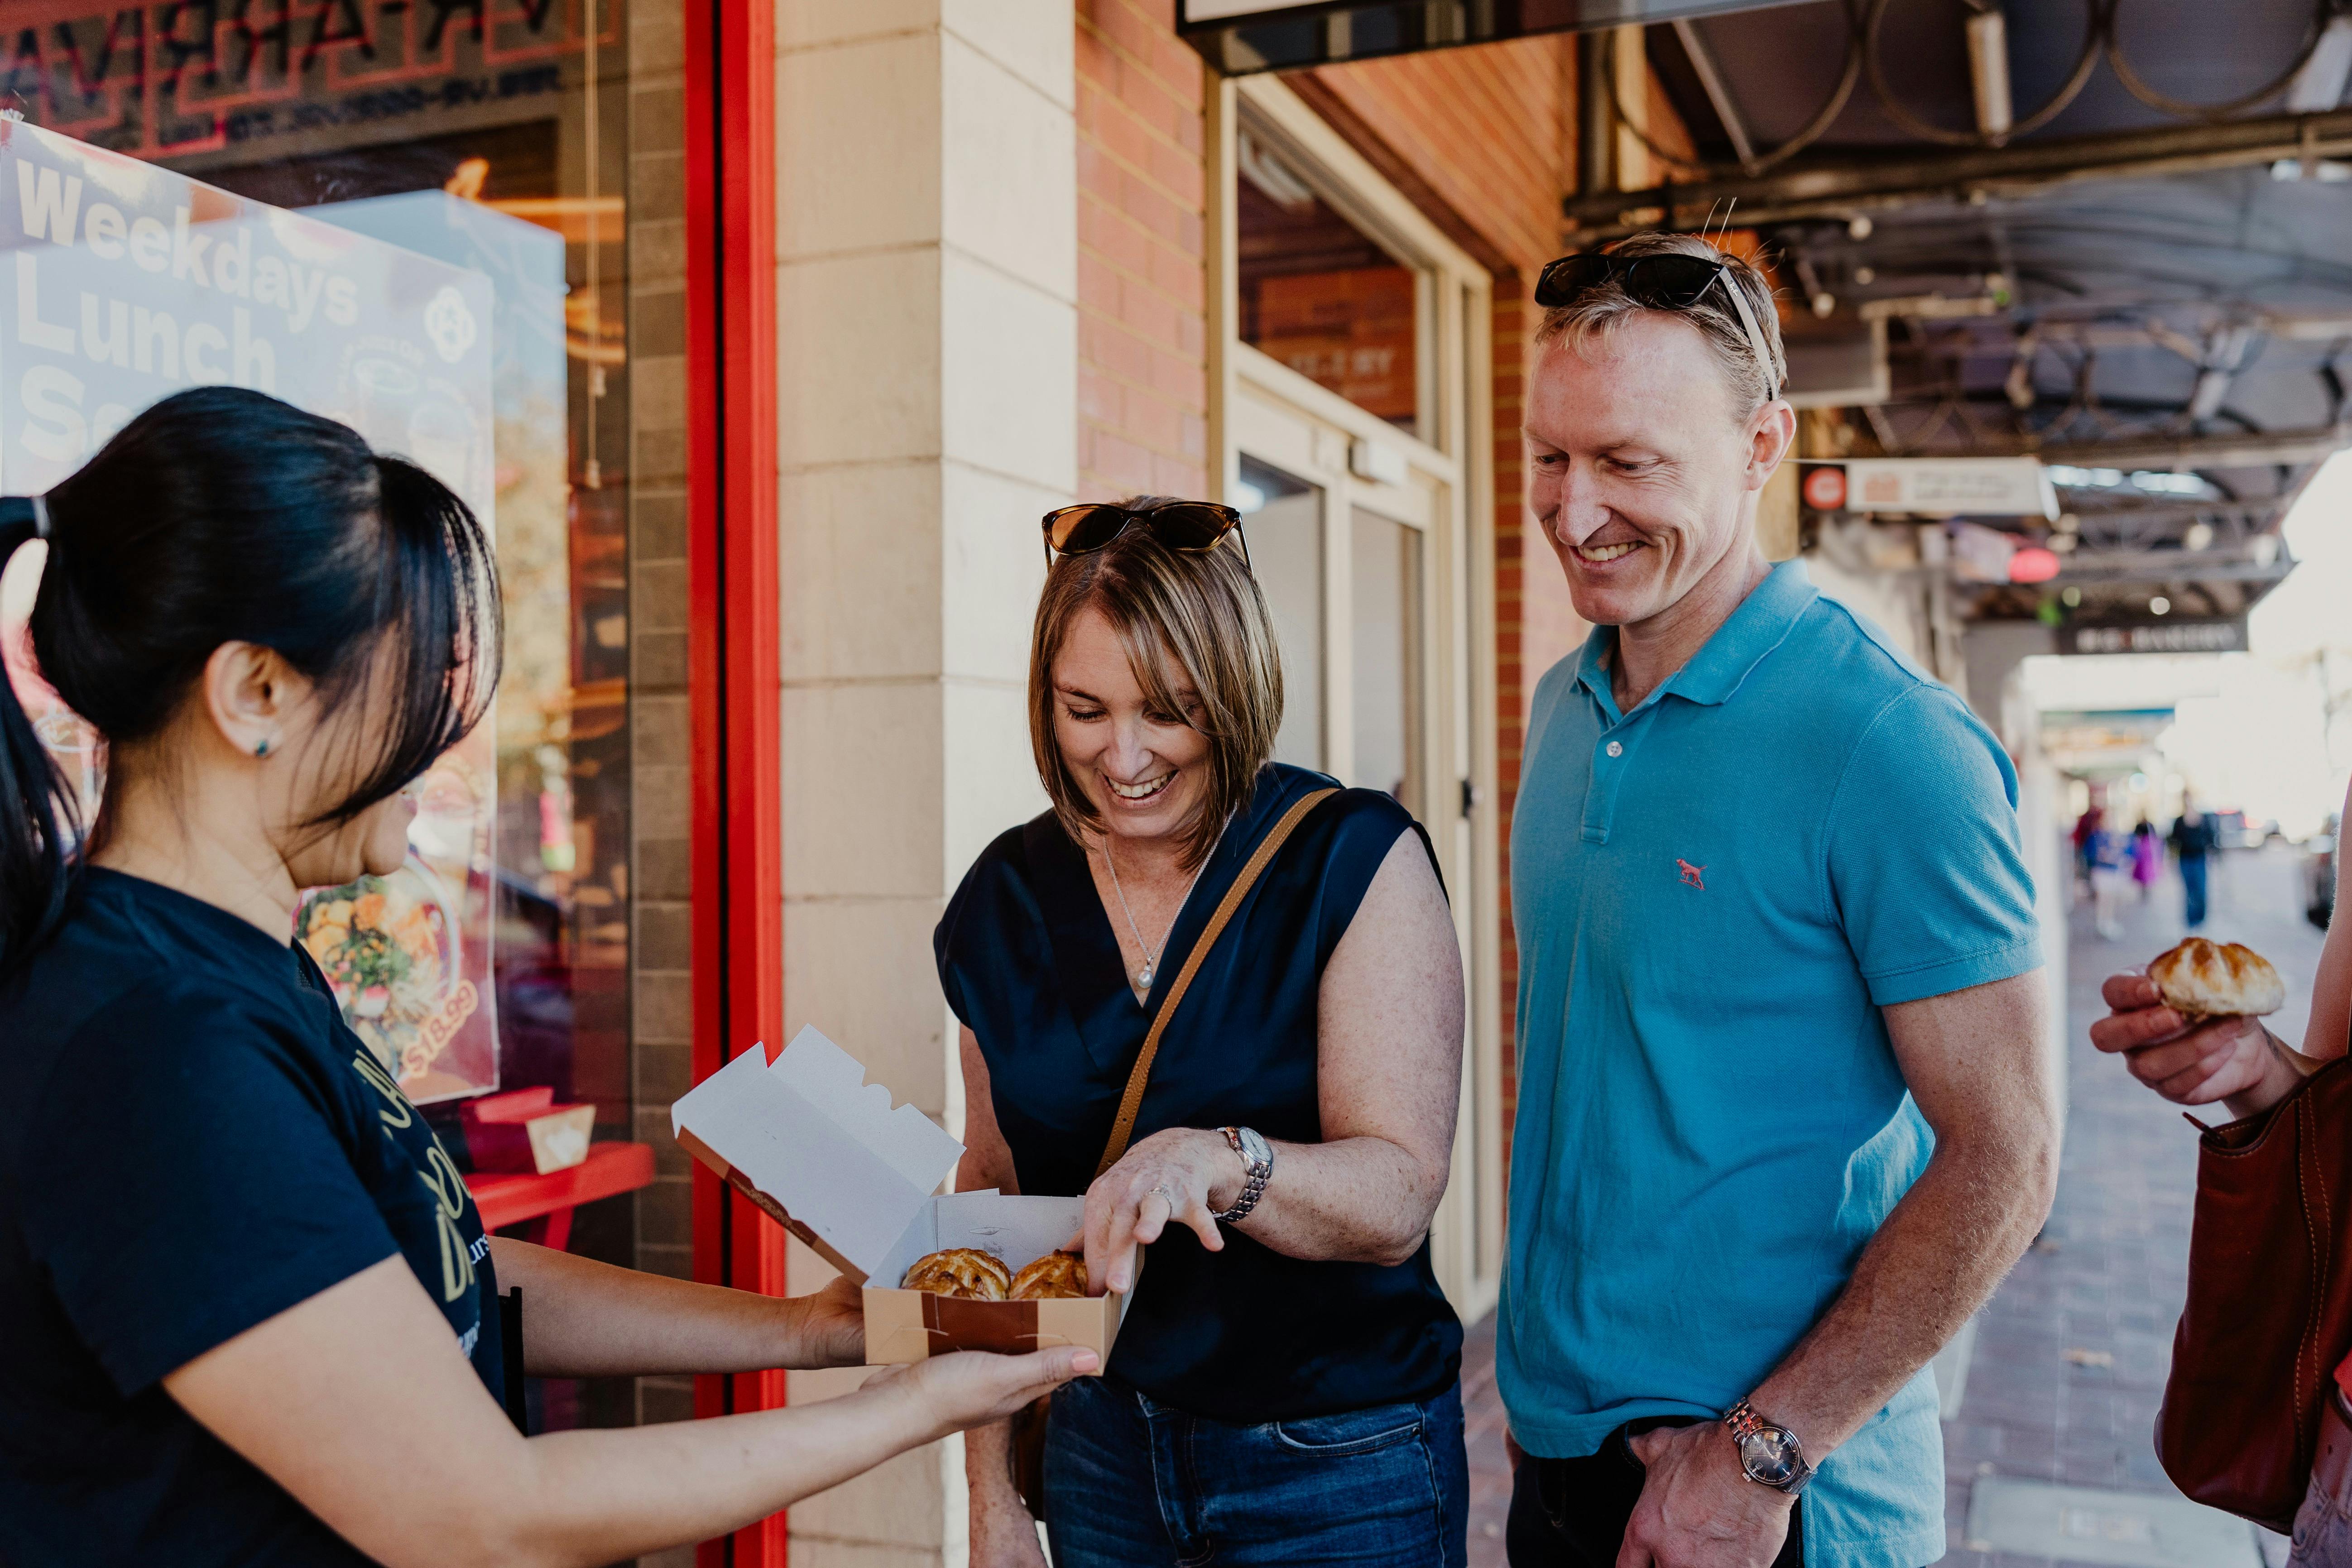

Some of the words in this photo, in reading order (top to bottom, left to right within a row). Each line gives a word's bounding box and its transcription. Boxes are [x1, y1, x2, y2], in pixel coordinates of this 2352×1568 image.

[16, 158, 359, 334] Weekdays
[16, 250, 276, 393] Lunch
[408, 986, 473, 1073] $18.99
